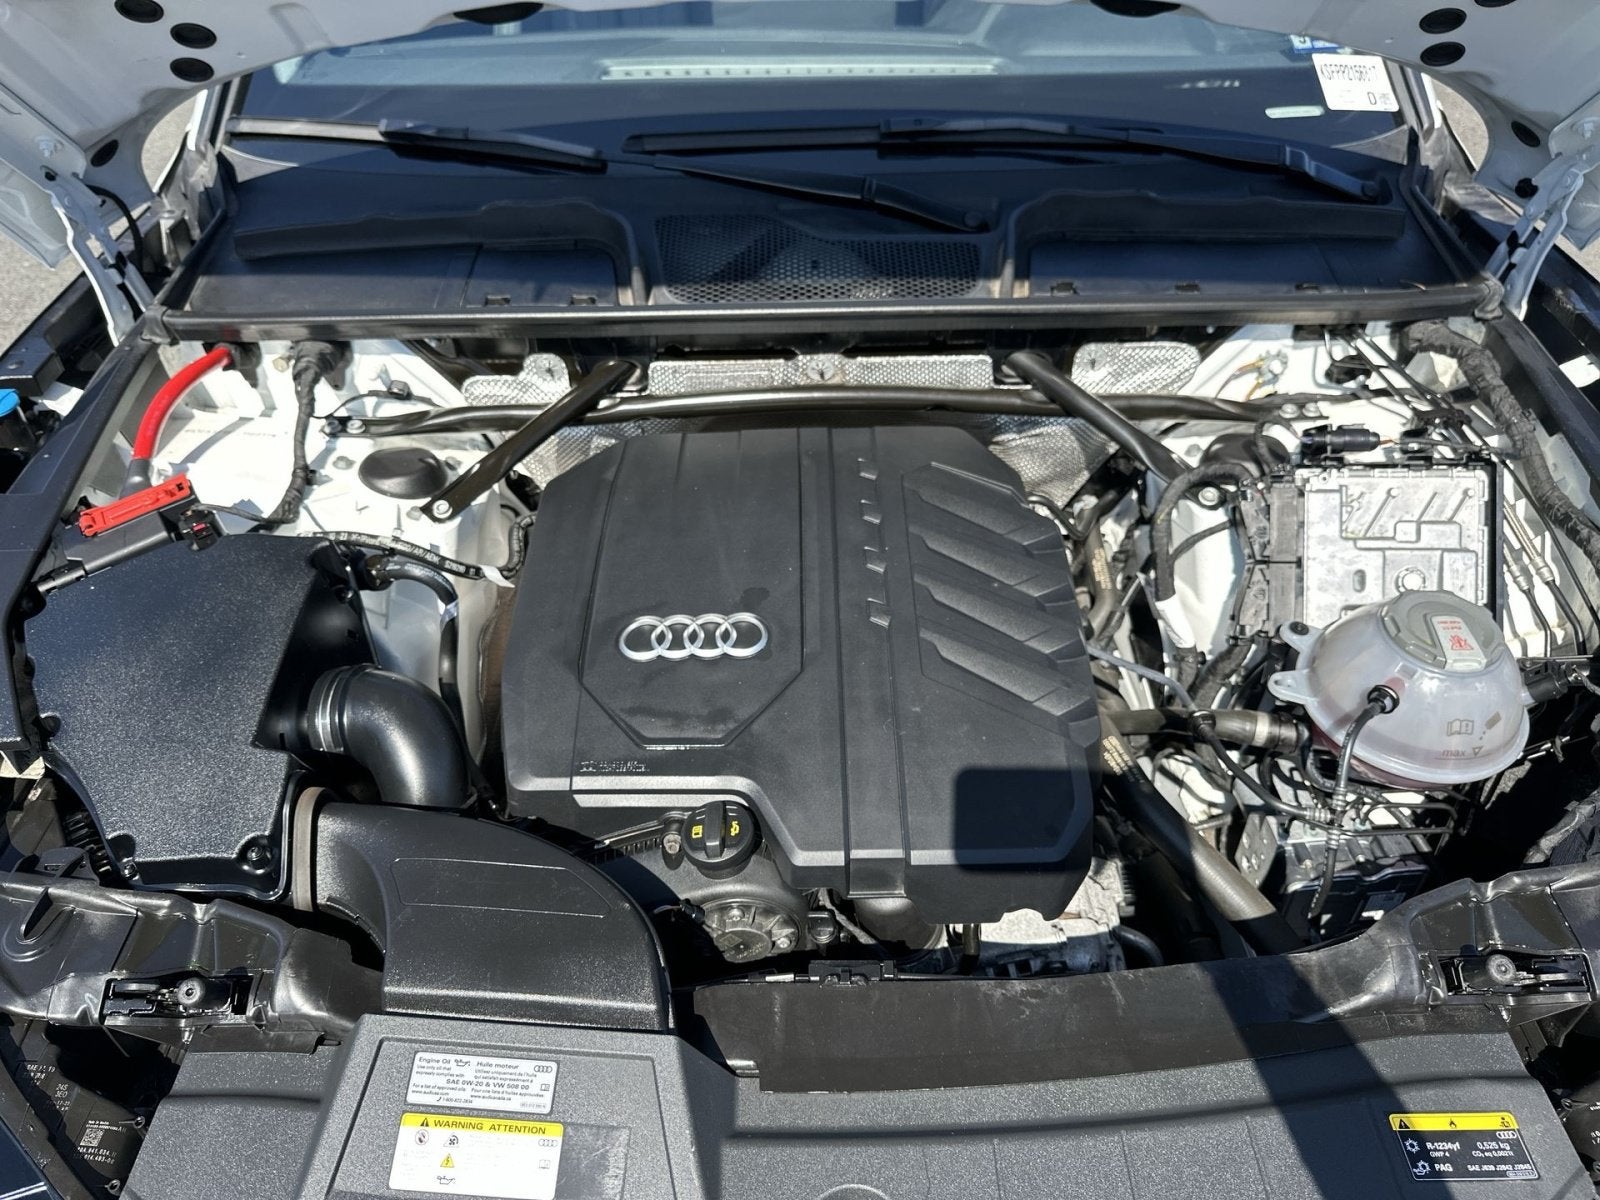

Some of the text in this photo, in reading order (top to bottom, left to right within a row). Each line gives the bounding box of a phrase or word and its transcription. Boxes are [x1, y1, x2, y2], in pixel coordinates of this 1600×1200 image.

[1442, 749, 1466, 757] max
[419, 1056, 440, 1064] Engine
[433, 1119, 546, 1136] WARNING ATTENTION
[1426, 1141, 1511, 1151] R-1234yf 0,525 kg
[1434, 1163, 1454, 1172] PAG
